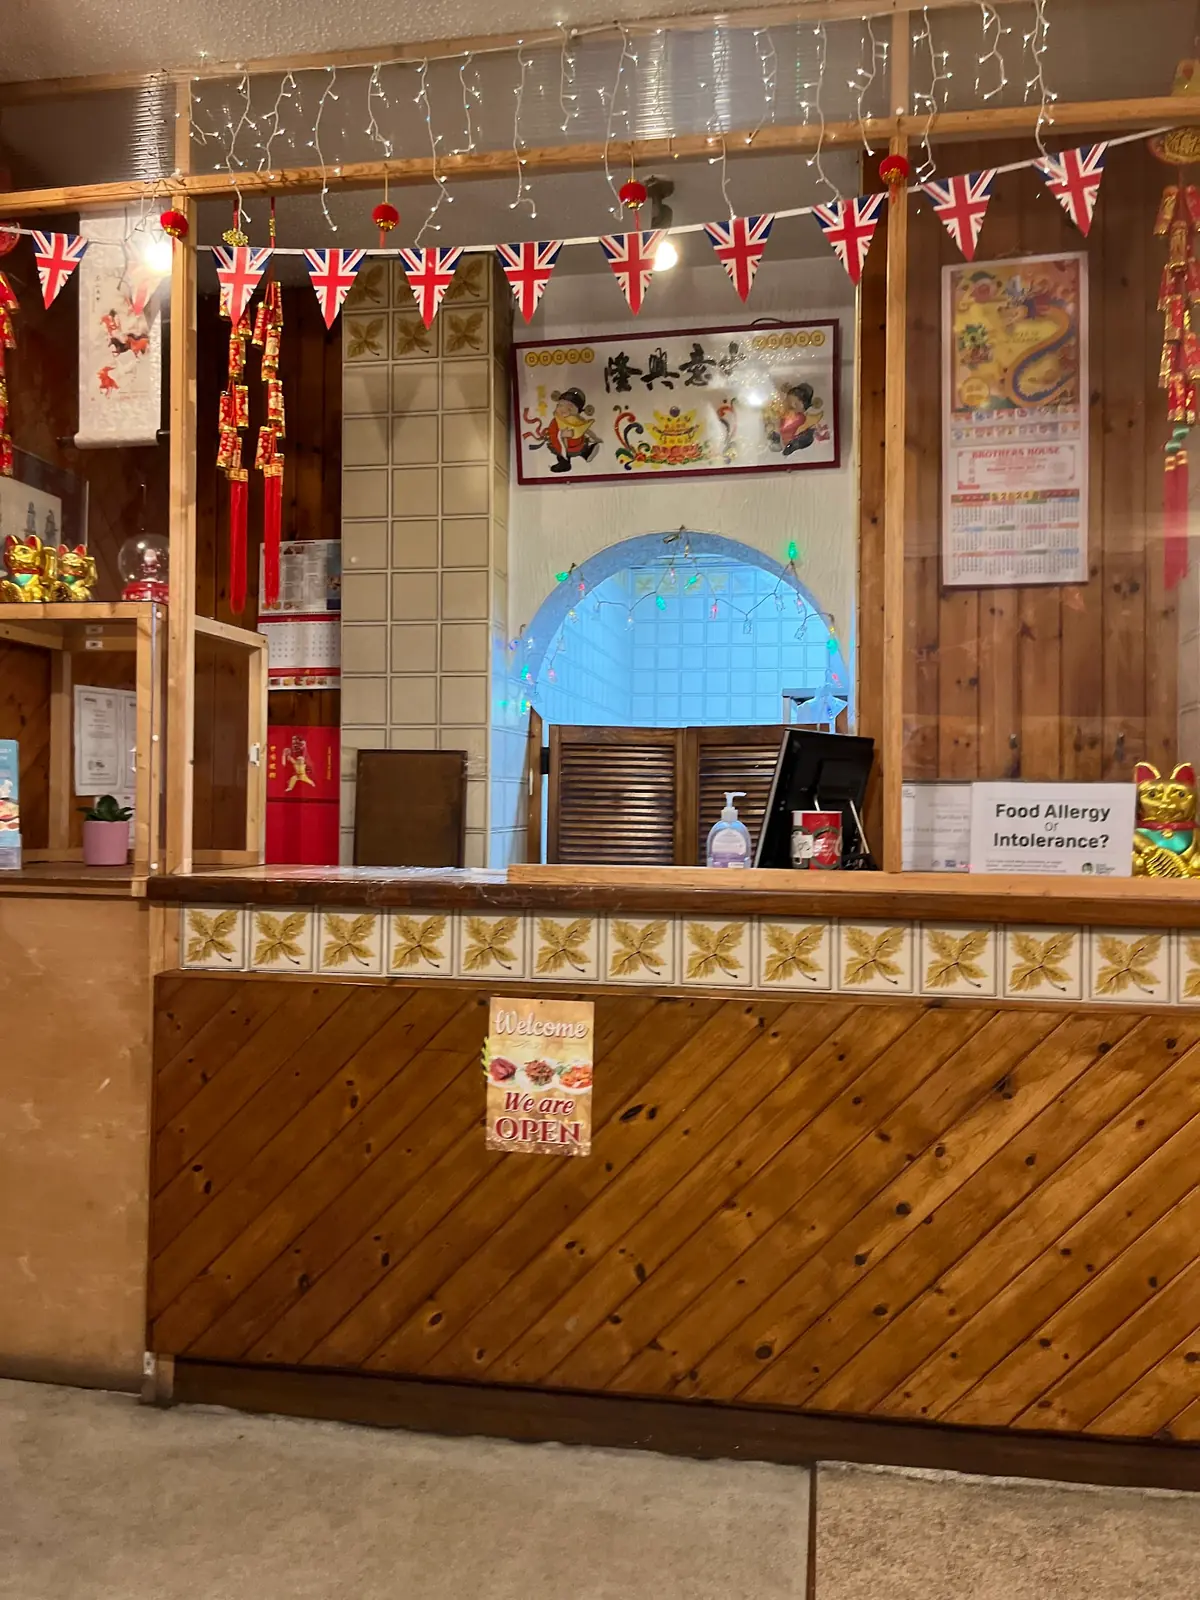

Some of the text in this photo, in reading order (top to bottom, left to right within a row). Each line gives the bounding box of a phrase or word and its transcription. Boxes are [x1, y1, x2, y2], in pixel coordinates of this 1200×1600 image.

[971, 446, 1060, 459] BROTHERS HOUSE
[995, 804, 1111, 822] Food Allergy
[993, 832, 1110, 848] Intolerance?
[494, 1009, 589, 1039] Welcome
[504, 1092, 575, 1115] We are
[494, 1117, 583, 1145] OPEN
